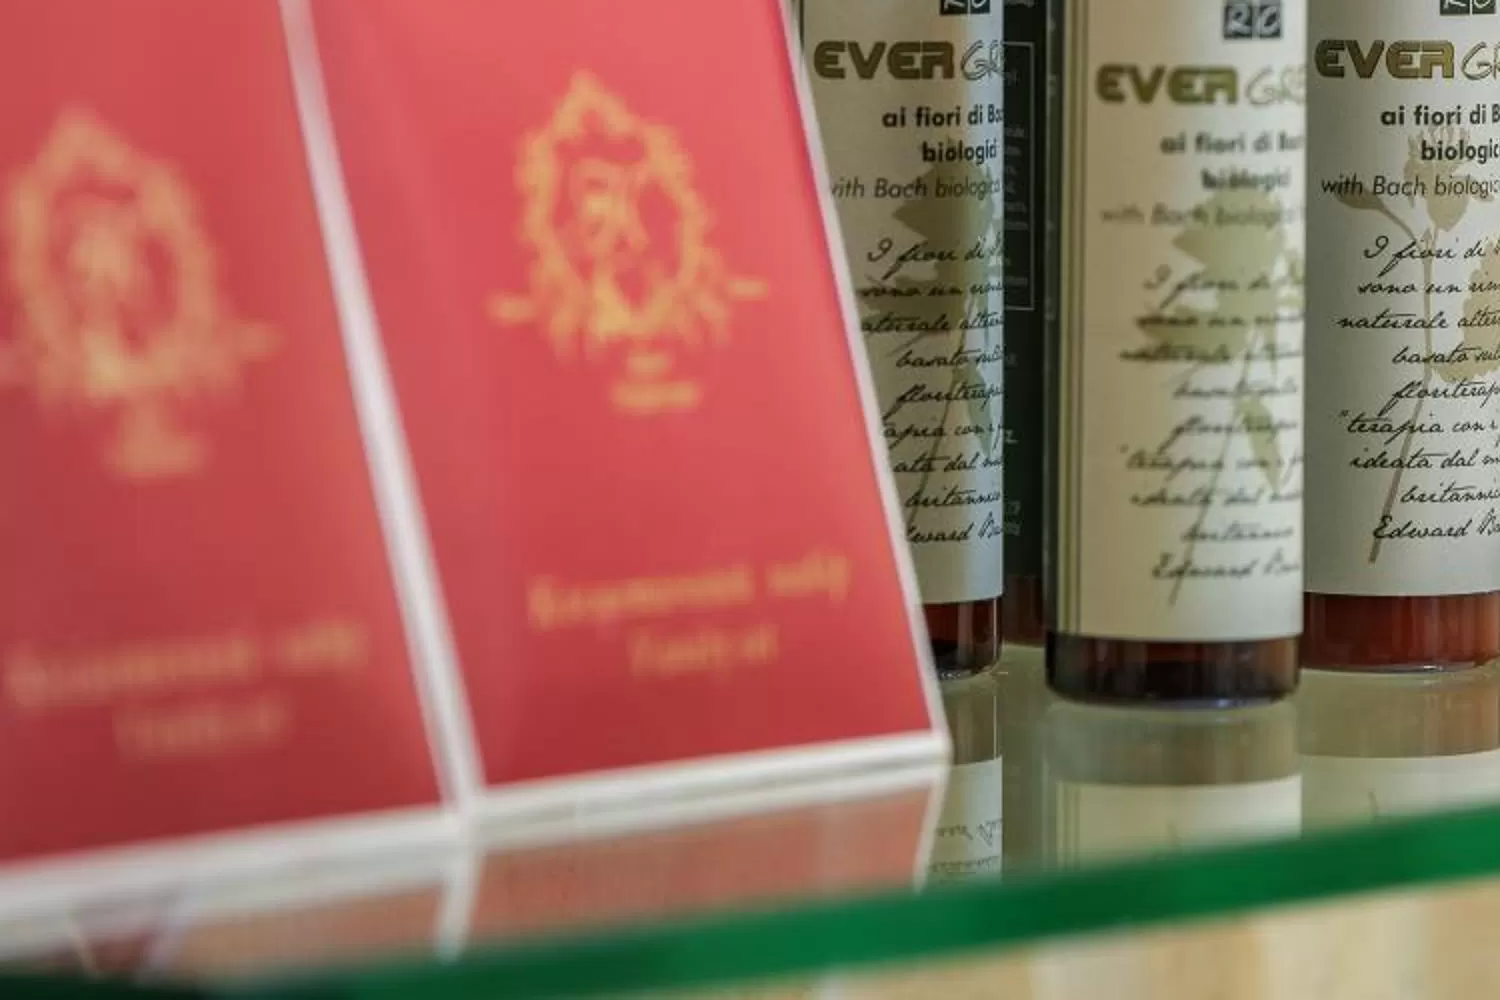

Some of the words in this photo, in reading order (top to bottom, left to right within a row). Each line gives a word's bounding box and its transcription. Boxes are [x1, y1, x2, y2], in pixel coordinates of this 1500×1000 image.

[813, 40, 955, 80] EVER
[1314, 39, 1455, 79] EVER
[1096, 64, 1238, 105] EVER
[882, 106, 906, 128] ai
[916, 106, 961, 128] fiori
[968, 104, 983, 124] di
[1380, 105, 1404, 126] ai
[1413, 104, 1462, 126] fiori
[1469, 103, 1487, 125] di
[1321, 174, 1363, 197] with
[1372, 174, 1426, 199] Bach
[1376, 236, 1457, 278] fiori
[1463, 236, 1487, 259] di
[861, 311, 951, 333] aturale
[1336, 307, 1450, 329] naturale
[1391, 342, 1470, 364] basato
[1348, 446, 1436, 469] ideata
[1439, 448, 1480, 469] dal
[1372, 514, 1474, 540] Edward
